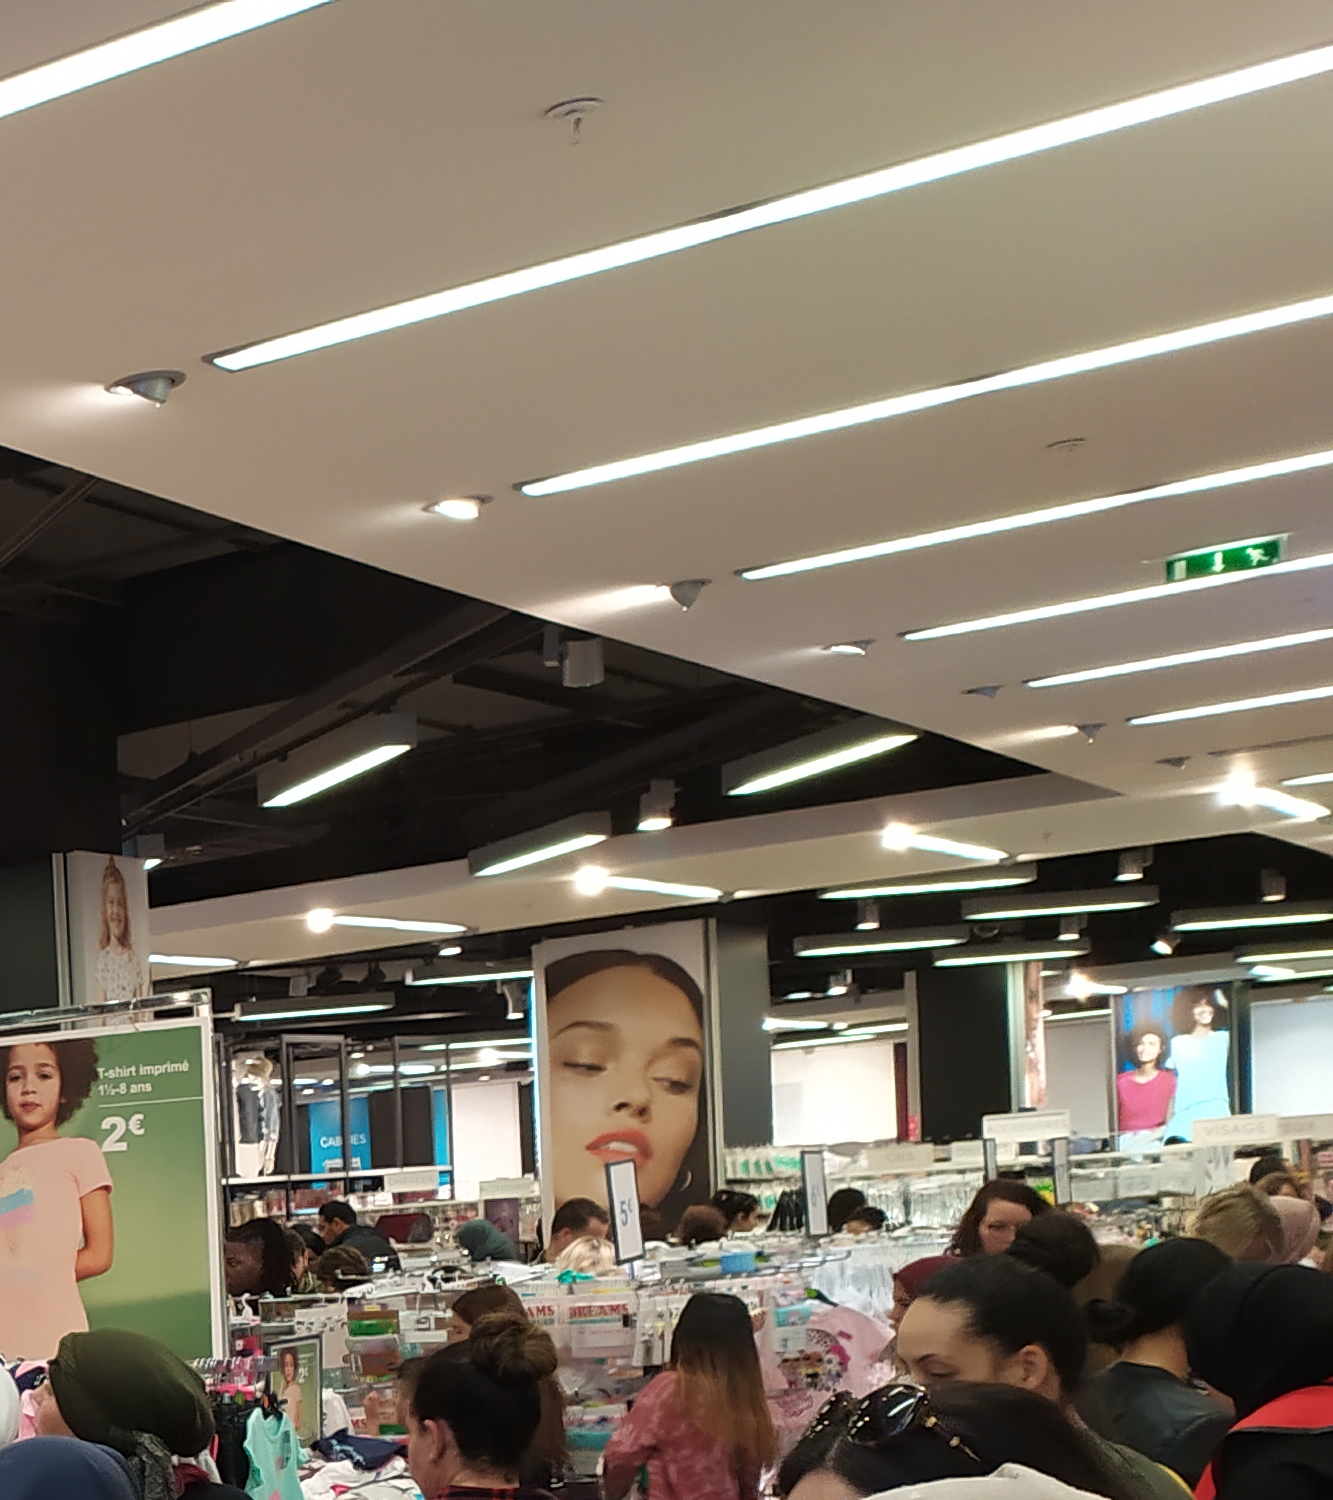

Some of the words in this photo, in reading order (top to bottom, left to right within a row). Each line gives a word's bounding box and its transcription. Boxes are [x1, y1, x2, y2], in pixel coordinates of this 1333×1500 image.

[96, 1064, 137, 1080] T-shirt
[139, 1059, 190, 1077] imprimé
[130, 1082, 153, 1094] ans
[100, 1113, 146, 1153] 2€
[319, 1131, 367, 1149] CABES
